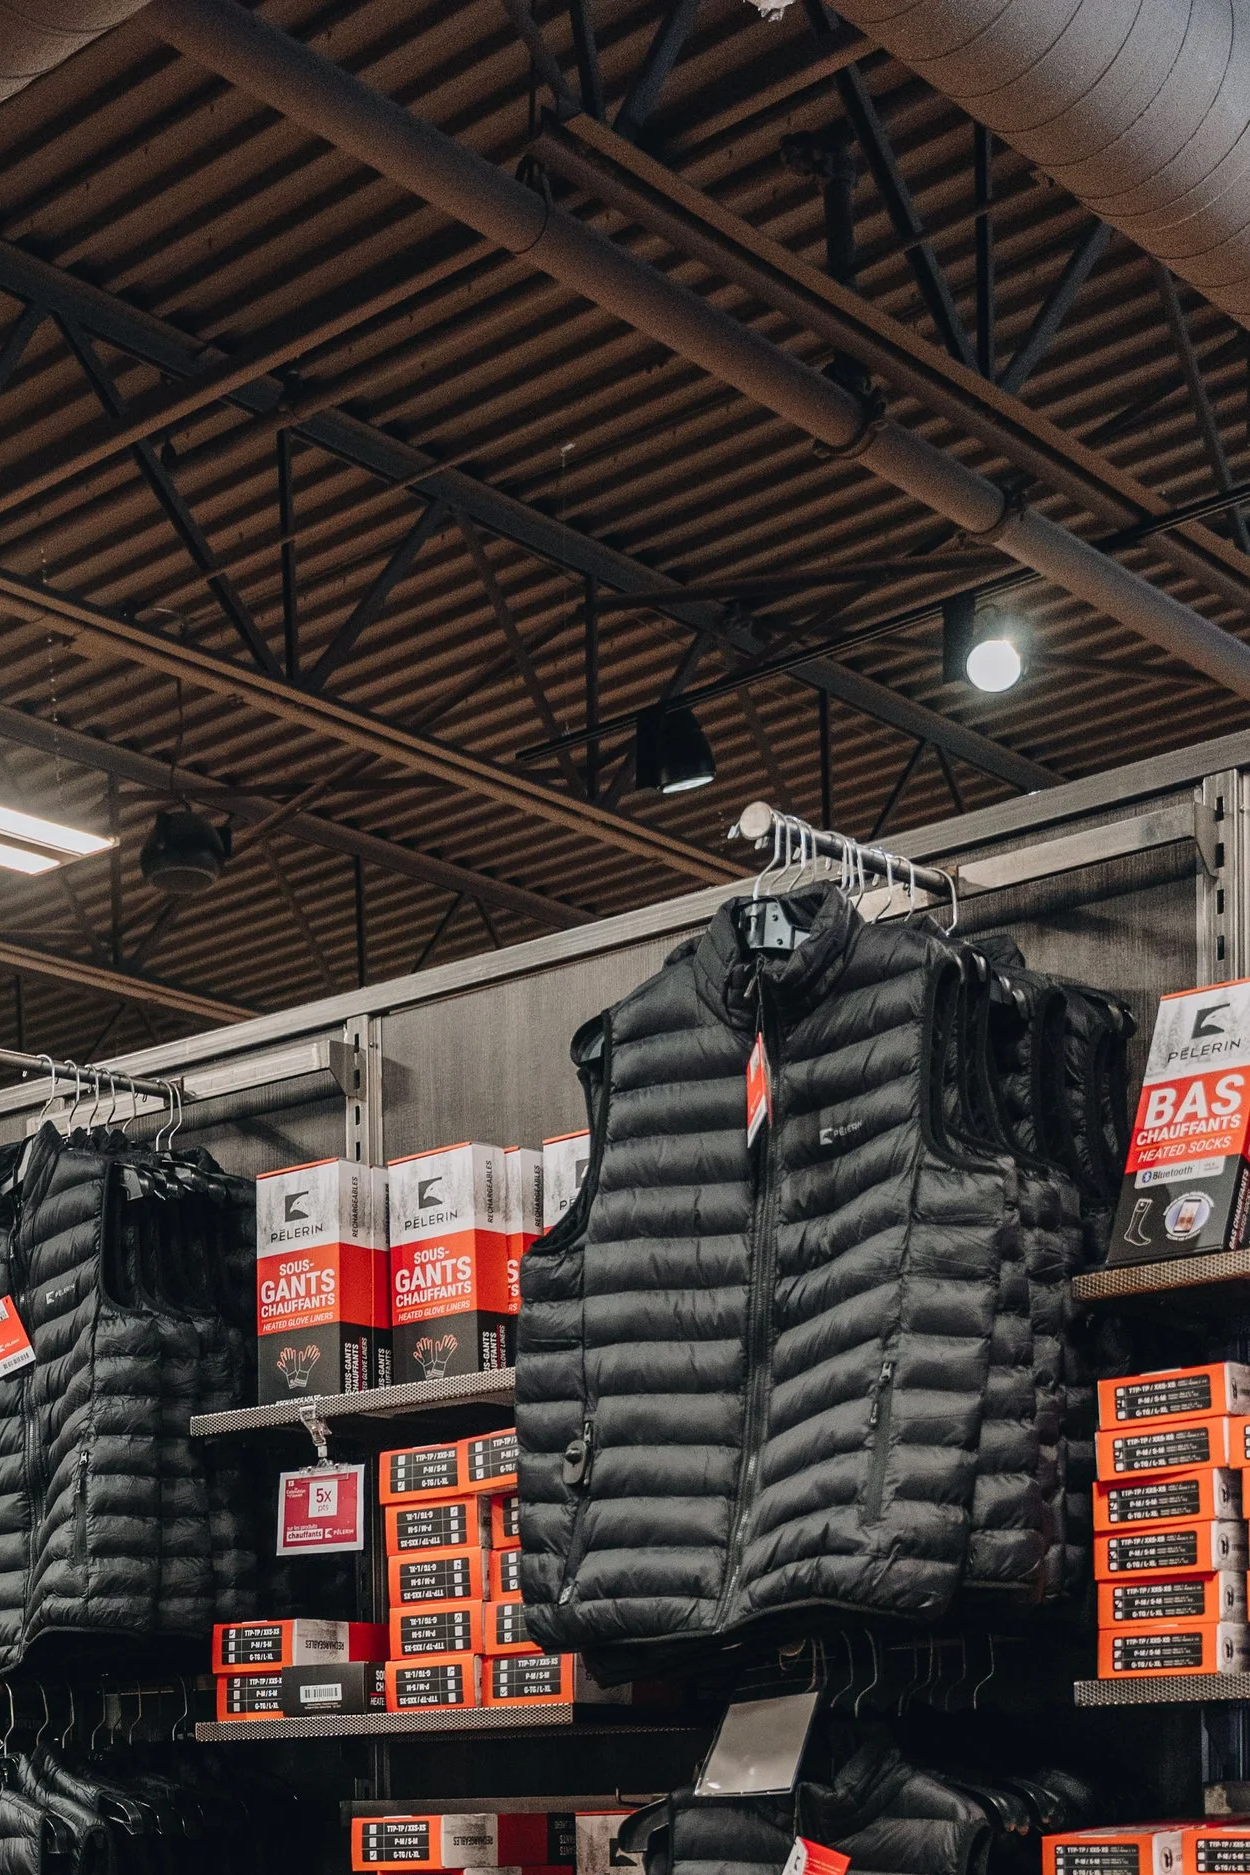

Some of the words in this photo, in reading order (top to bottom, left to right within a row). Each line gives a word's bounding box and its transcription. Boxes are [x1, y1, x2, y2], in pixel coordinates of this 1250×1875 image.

[1144, 1073, 1246, 1130] BAS
[1136, 1113, 1242, 1146] CHAUFFANTS
[1137, 1145, 1185, 1164] HEATED
[1188, 1135, 1232, 1153] SOCKS
[1152, 1165, 1193, 1181] Bluetooth
[351, 1176, 359, 1238] RECHARGEABLES
[413, 1246, 450, 1265] SOUS-
[279, 1259, 315, 1275] SOUS-
[395, 1256, 472, 1293] GANTS
[261, 1268, 335, 1304] GANTS
[395, 1280, 472, 1307] CHAUFFANTS
[261, 1292, 335, 1318] CHAUFFANTS
[398, 1309, 423, 1321] HEATED
[424, 1305, 445, 1317] GLOVE
[446, 1300, 470, 1313] LINERS
[263, 1320, 287, 1332] HEATED
[288, 1316, 309, 1328] GLOVE
[310, 1312, 334, 1323] LINERS
[316, 1487, 332, 1503] 5x
[317, 1504, 330, 1513] pts
[288, 1530, 322, 1540] chauffants
[305, 1640, 344, 1650] RECHARGEABLES
